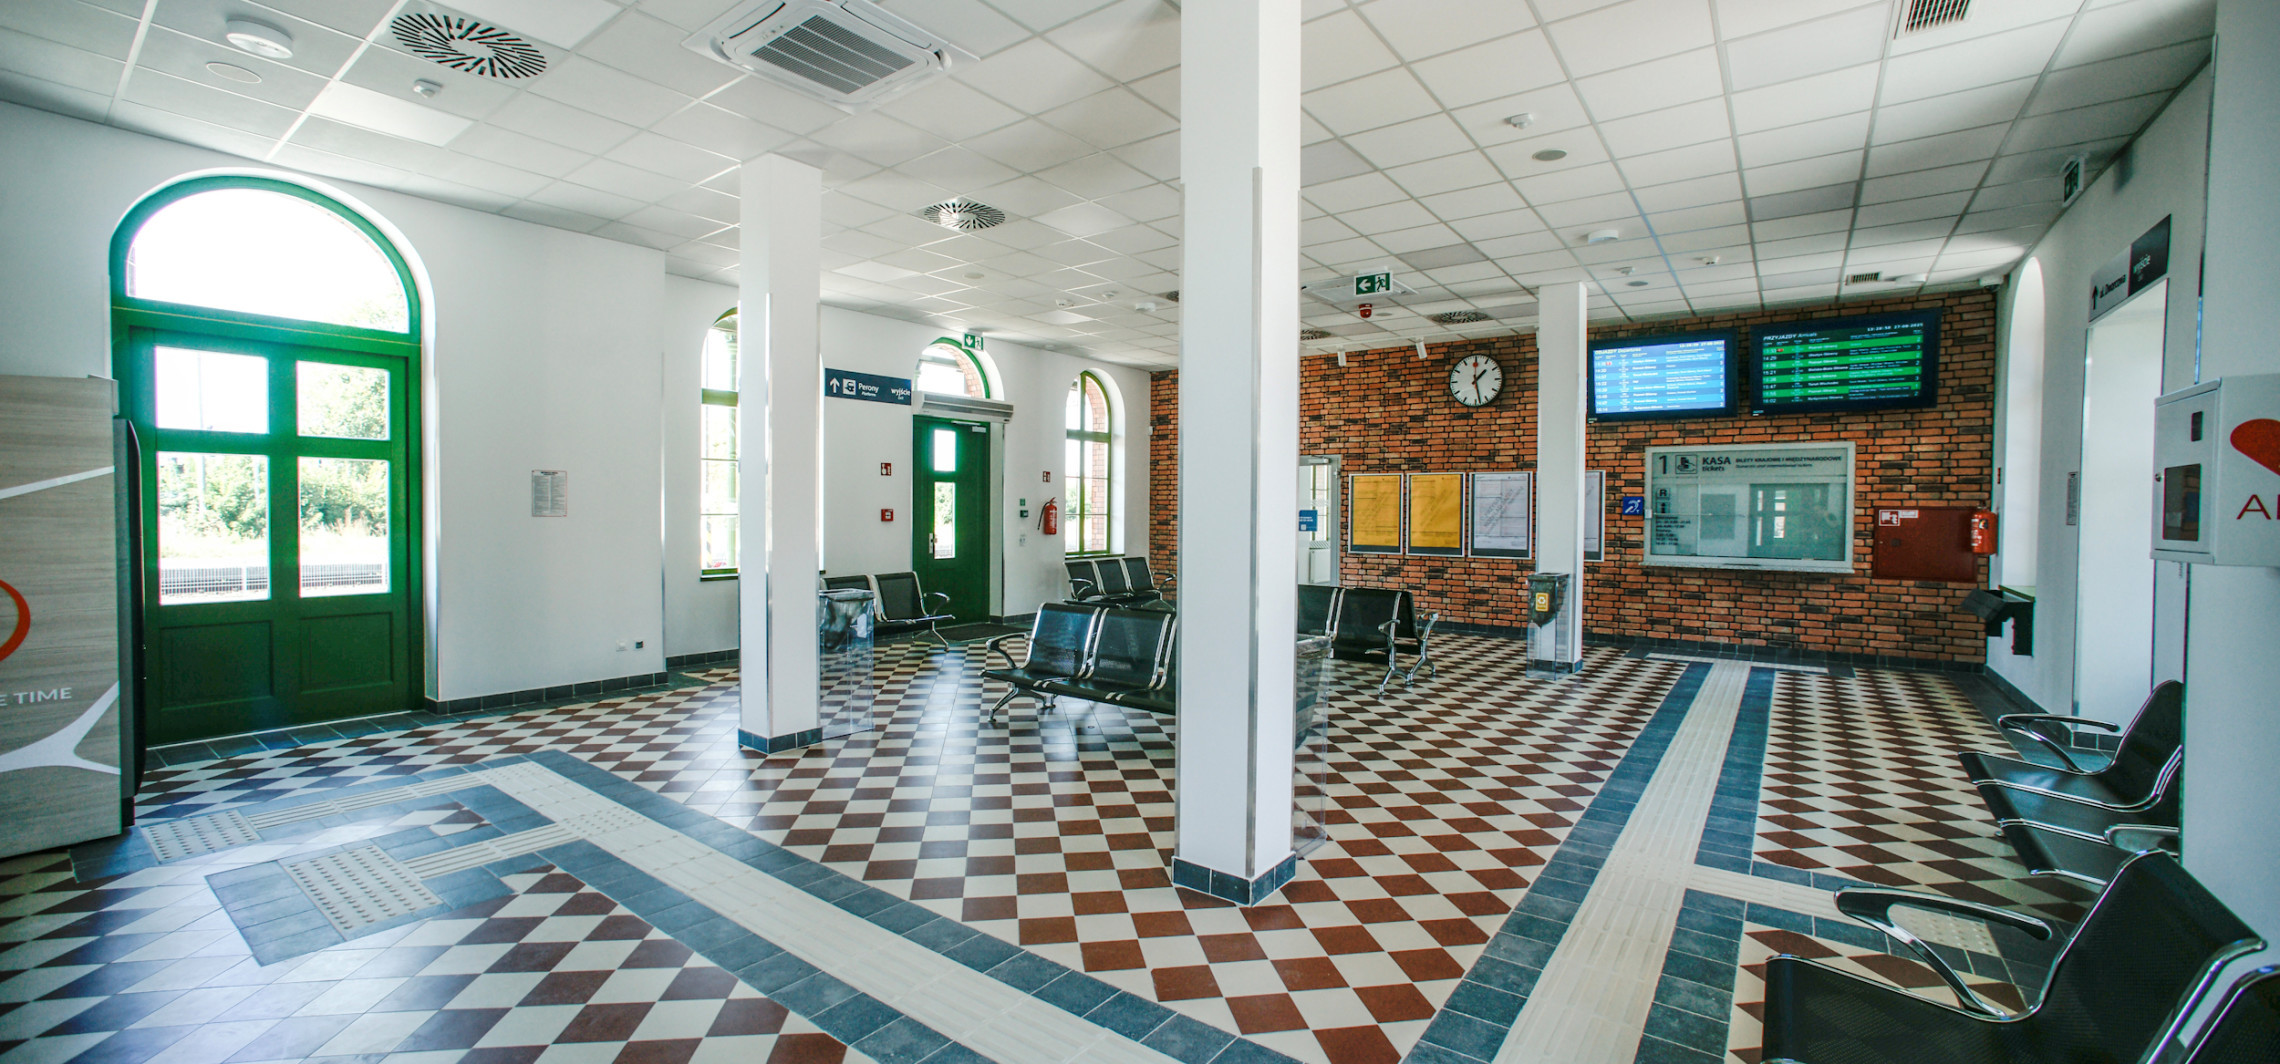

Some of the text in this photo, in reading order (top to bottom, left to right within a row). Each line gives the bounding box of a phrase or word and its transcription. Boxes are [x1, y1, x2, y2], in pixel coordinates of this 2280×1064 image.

[859, 383, 879, 393] Perony
[1659, 455, 1667, 474] 1
[1702, 456, 1731, 465] KASA
[14, 687, 72, 704] TIME
